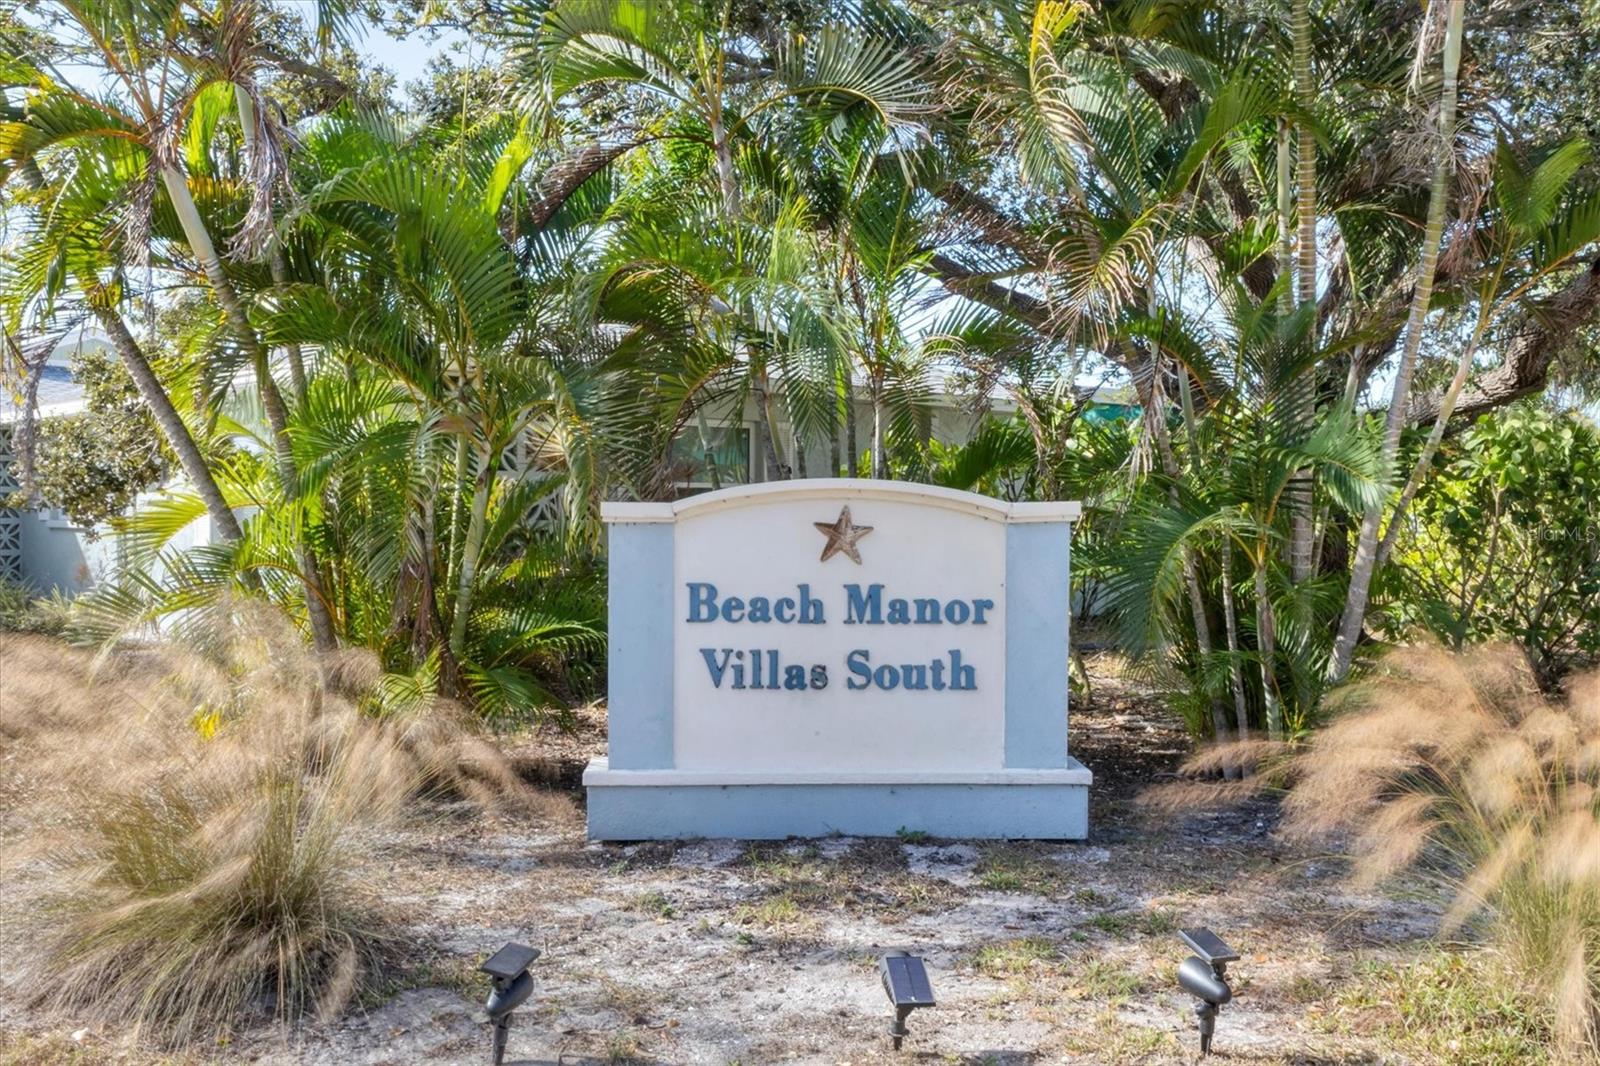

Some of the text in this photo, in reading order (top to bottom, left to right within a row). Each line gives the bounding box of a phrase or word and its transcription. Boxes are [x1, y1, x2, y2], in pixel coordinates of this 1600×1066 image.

[686, 583, 995, 626] Beach Manor
[699, 648, 978, 692] Villas South
